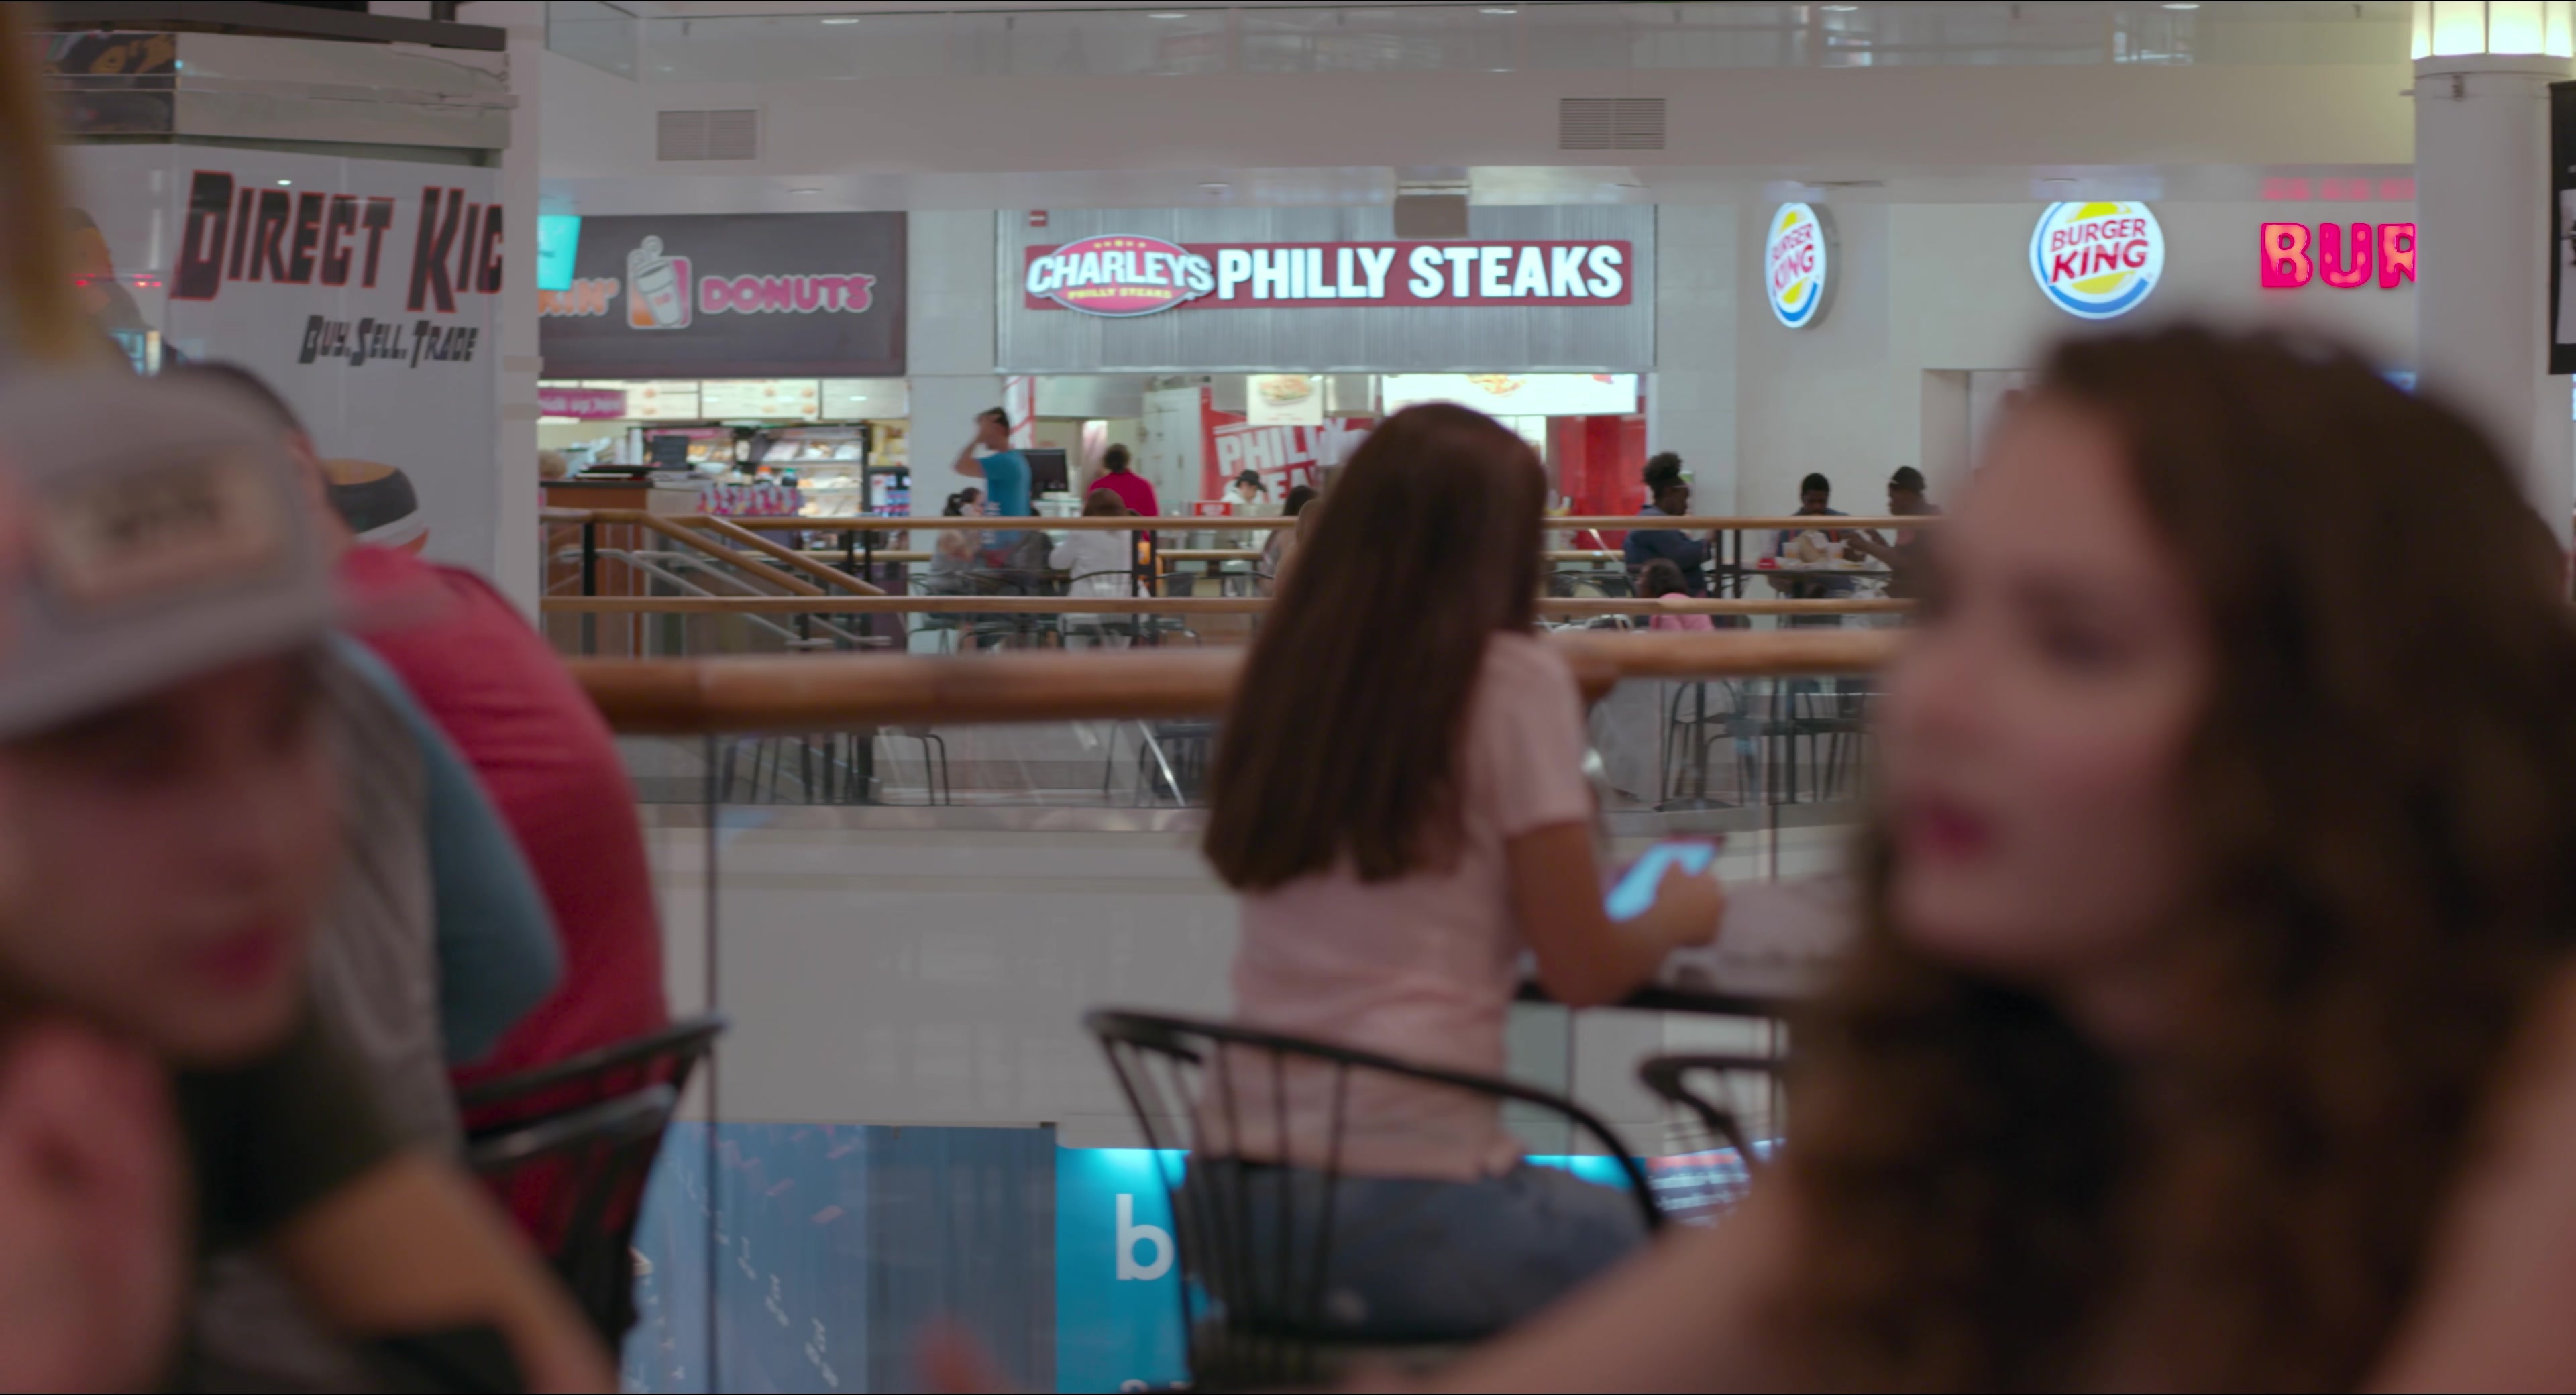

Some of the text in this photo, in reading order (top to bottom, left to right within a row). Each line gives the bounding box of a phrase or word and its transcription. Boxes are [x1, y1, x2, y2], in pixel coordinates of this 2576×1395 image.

[2051, 218, 2147, 252] BURGER
[2261, 223, 2416, 288] BUR
[1026, 249, 1215, 293] CHARLEYS
[1217, 245, 1623, 299] PHILLY STEAKS
[1775, 244, 1814, 290] KING
[2051, 239, 2149, 284] KING
[699, 274, 876, 314] DONUTS
